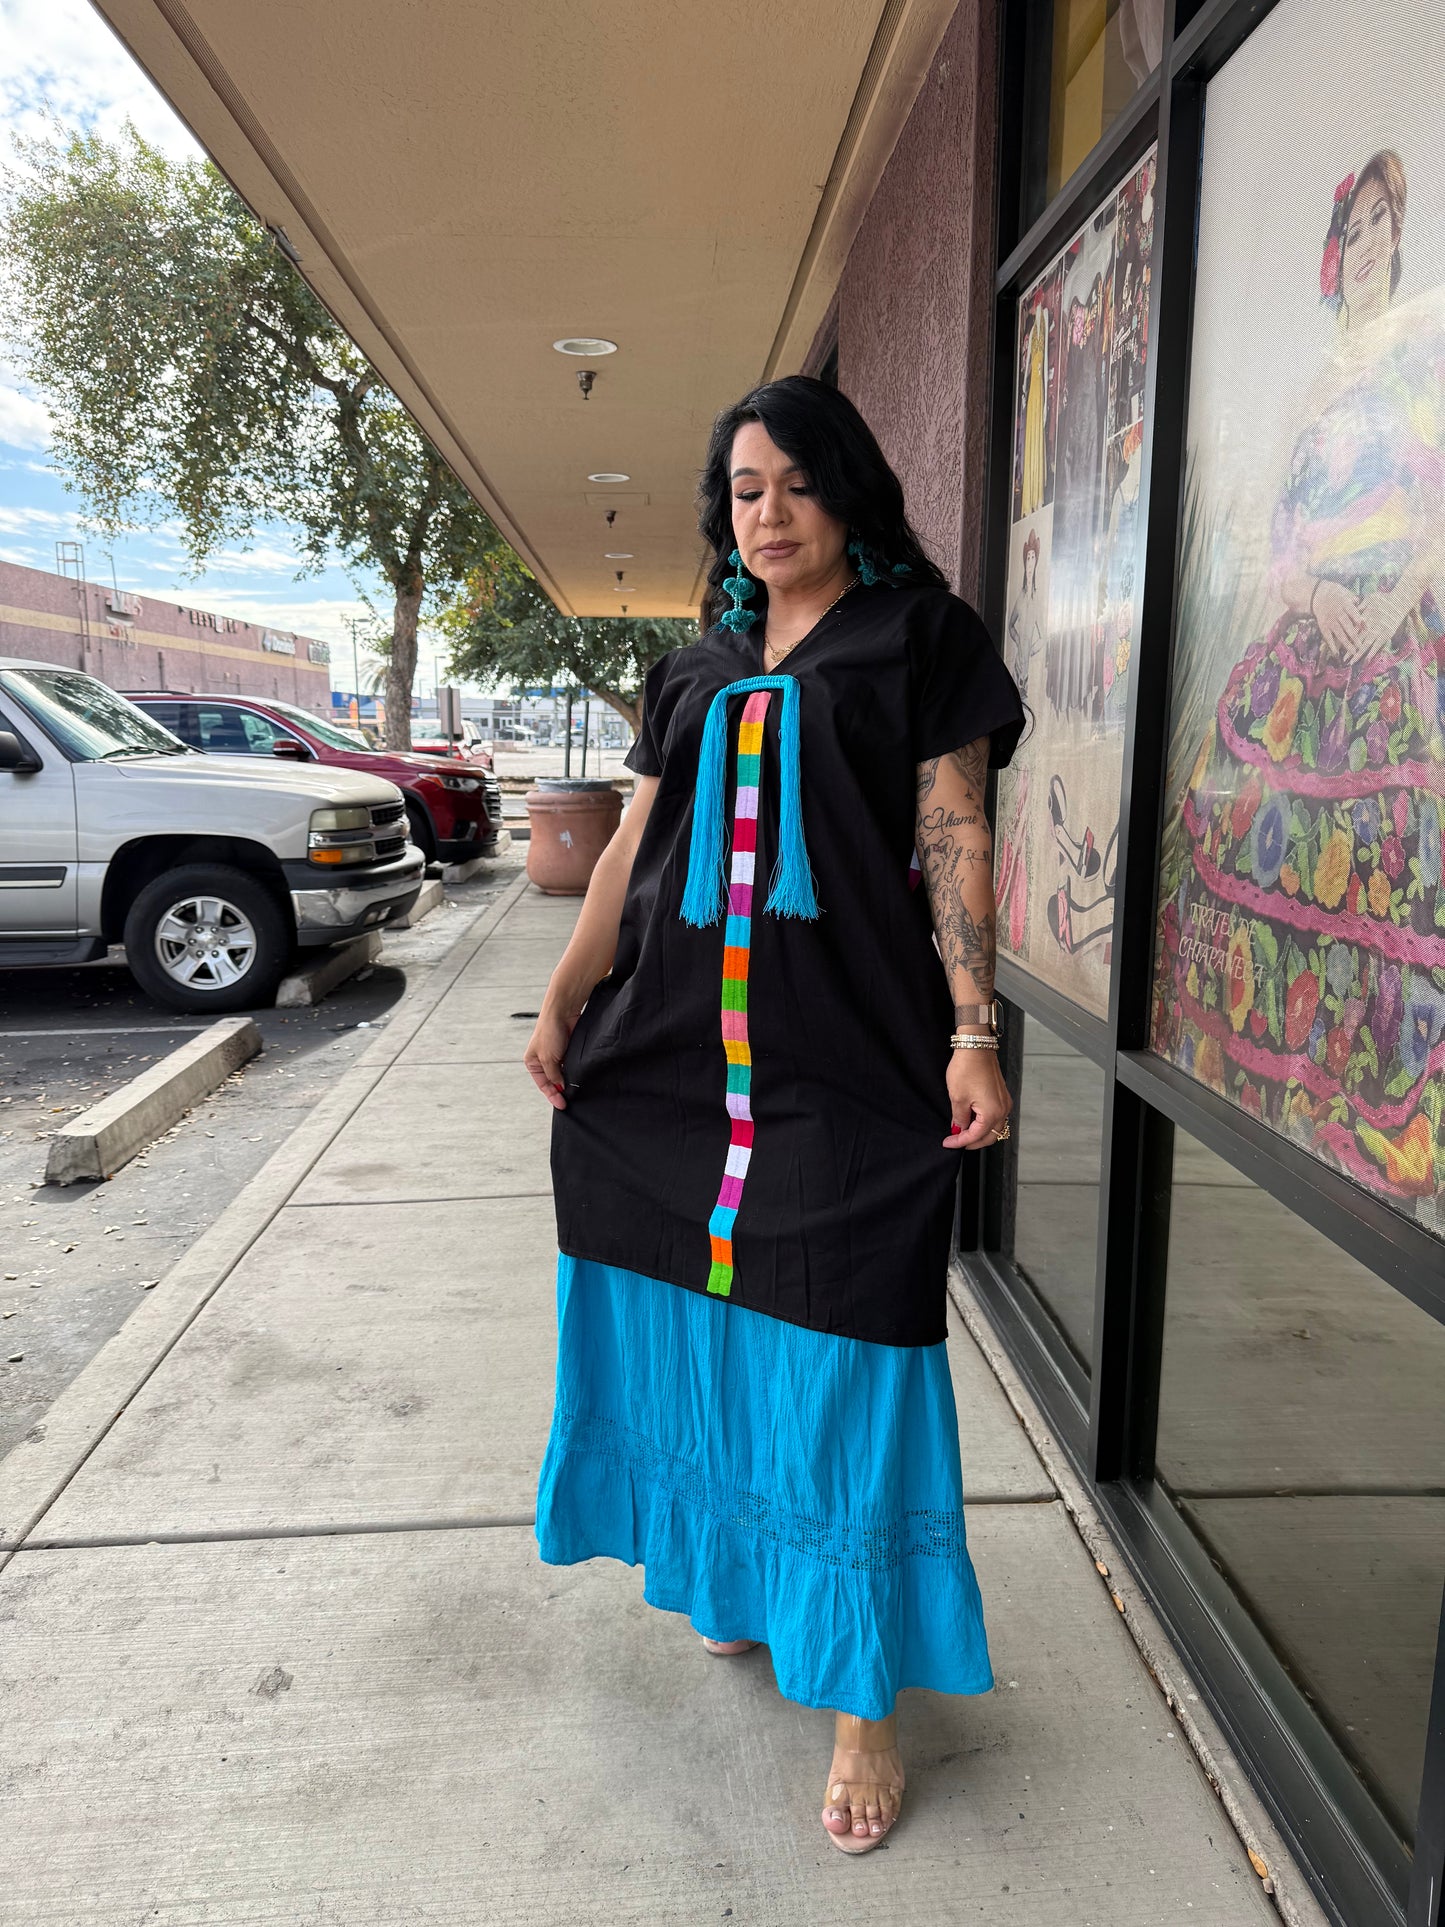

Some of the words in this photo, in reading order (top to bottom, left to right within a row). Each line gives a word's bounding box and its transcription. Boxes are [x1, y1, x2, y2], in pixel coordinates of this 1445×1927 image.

[1190, 902, 1236, 937] TRAJES
[1239, 917, 1257, 945] DE
[1178, 935, 1265, 989] CHIAPANECA
